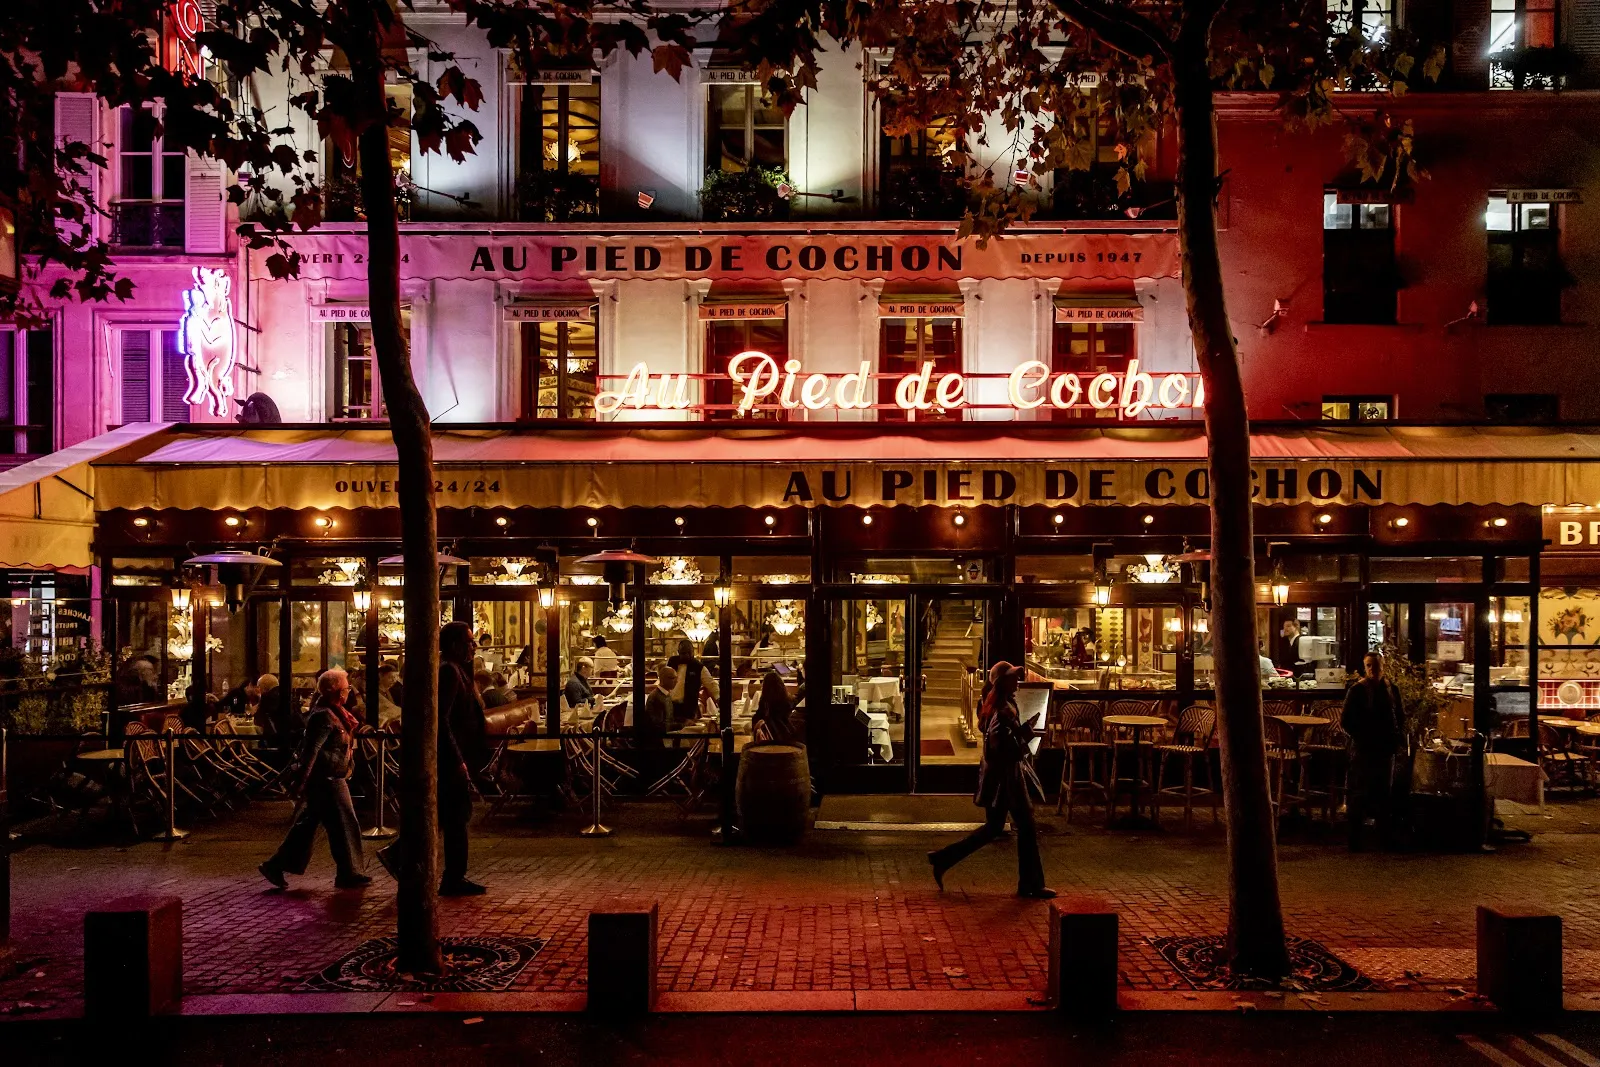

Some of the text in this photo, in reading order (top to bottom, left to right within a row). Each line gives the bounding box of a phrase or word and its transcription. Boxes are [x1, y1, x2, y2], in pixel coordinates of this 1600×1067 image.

[709, 71, 717, 80] AU
[720, 71, 735, 80] PIED
[300, 253, 345, 264] VERT
[470, 245, 962, 272] AU PIED DE COCHON
[1021, 252, 1143, 264] DEPUIS 1947
[319, 309, 328, 318] AU
[331, 309, 346, 318] PIED
[349, 309, 358, 318] DE
[512, 309, 580, 318] AU PIED DE COCHON
[708, 308, 776, 317] AU PIED DE COCHON
[888, 305, 956, 314] AU PIED DE COCHON
[1066, 310, 1134, 319] AU PIED DE COCHON
[595, 351, 1206, 417] Au Pied de Cocho
[335, 480, 501, 493] OUVE 24/24
[783, 470, 851, 501] AU
[882, 469, 1017, 501] PIED
[1045, 468, 1117, 500] DE
